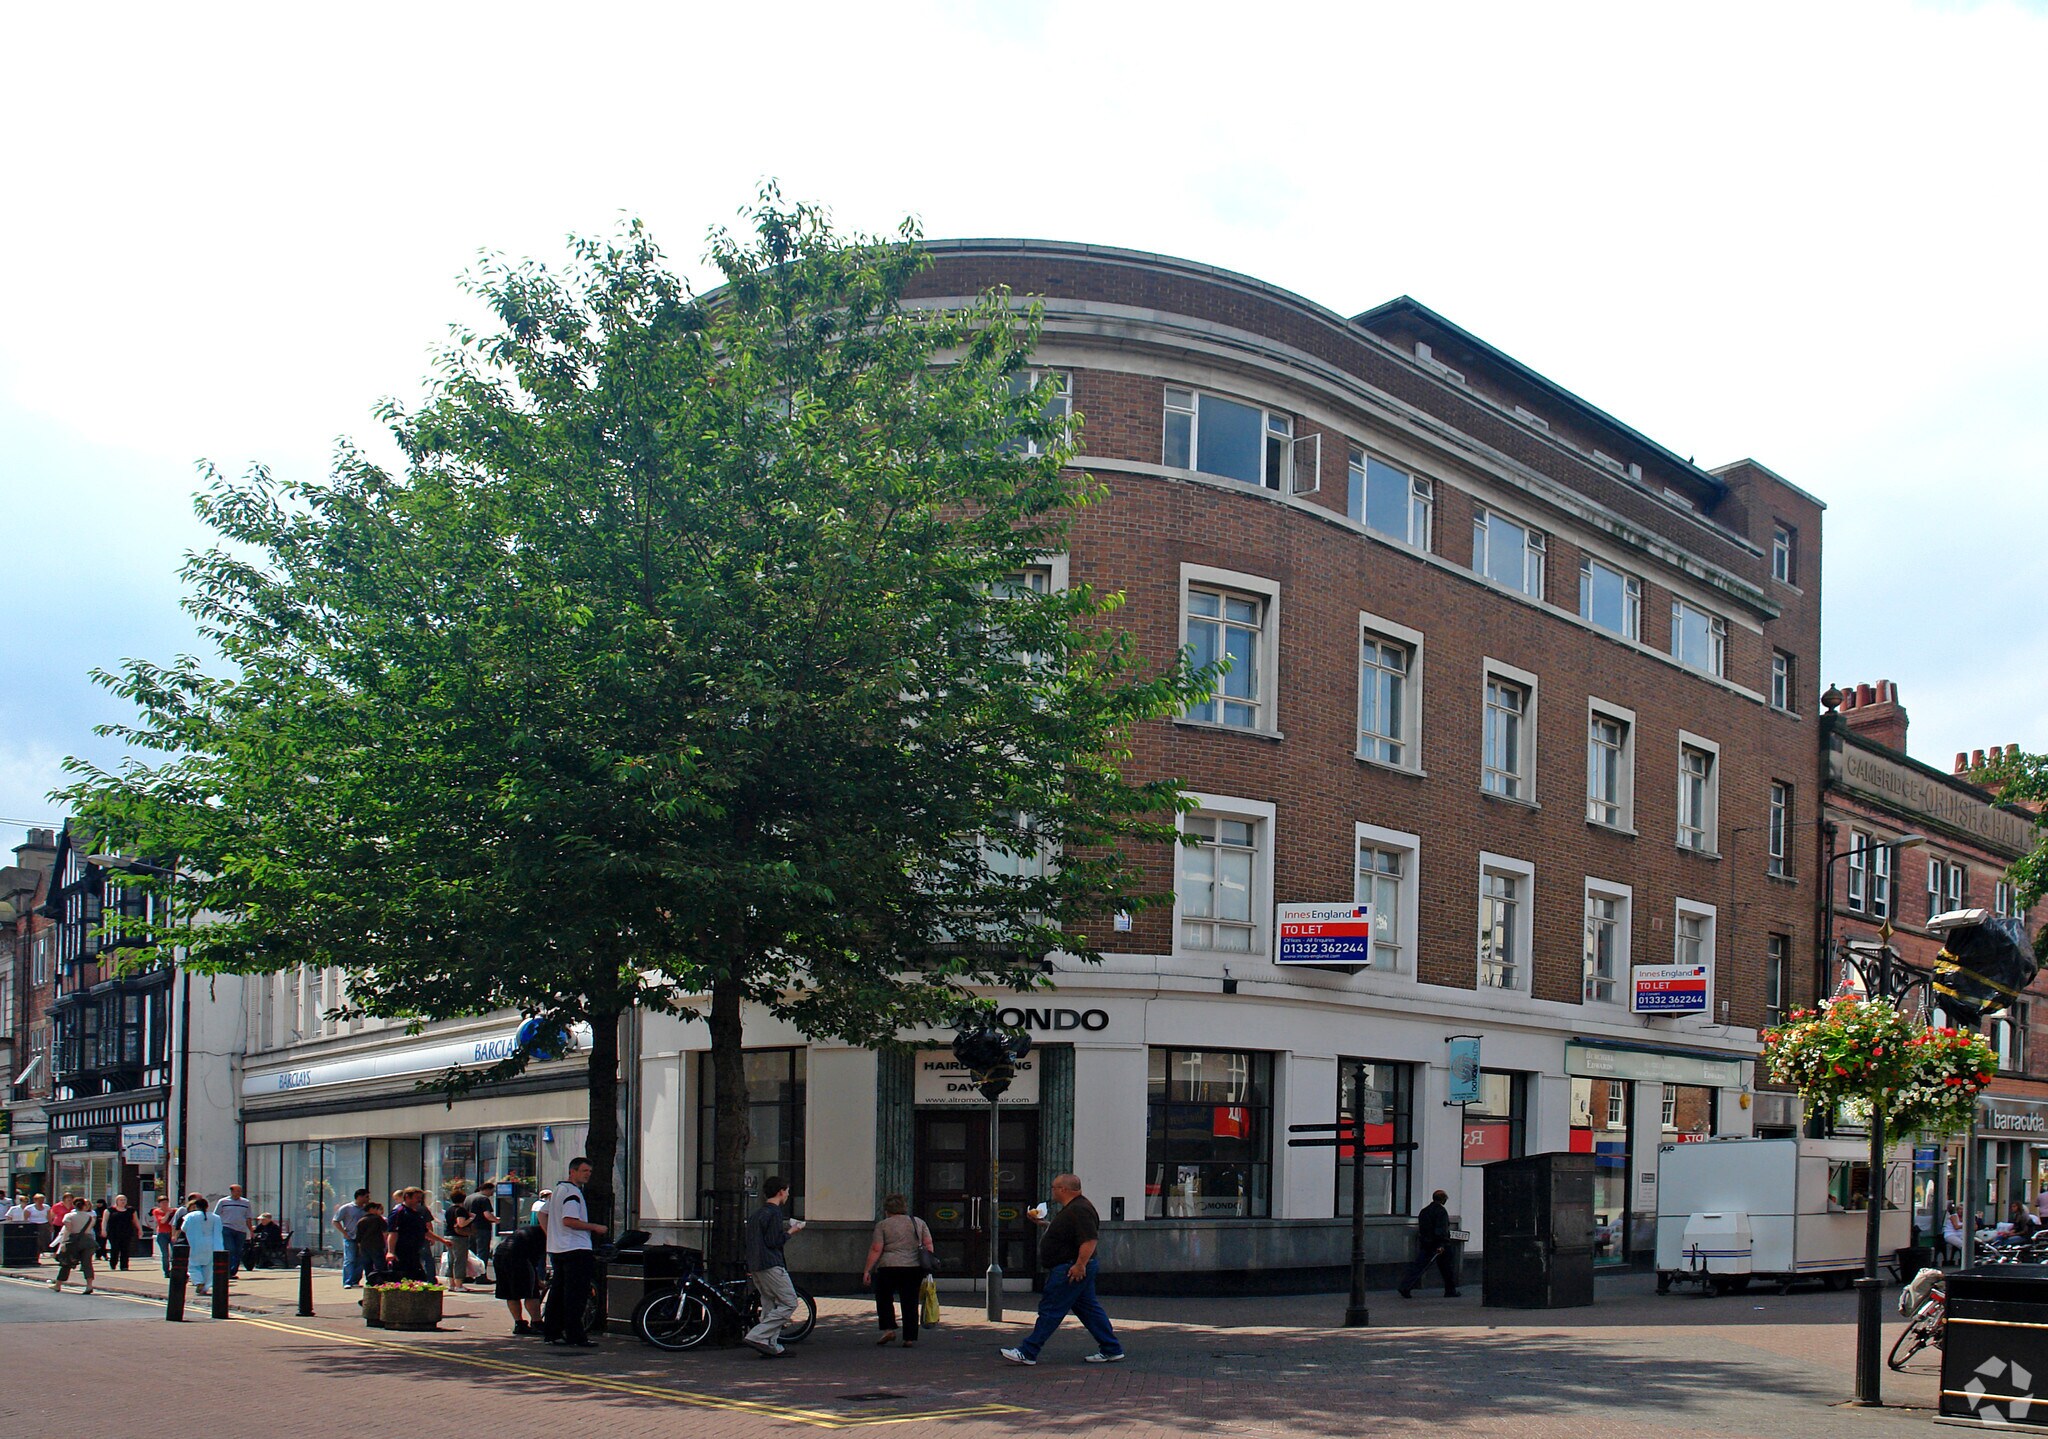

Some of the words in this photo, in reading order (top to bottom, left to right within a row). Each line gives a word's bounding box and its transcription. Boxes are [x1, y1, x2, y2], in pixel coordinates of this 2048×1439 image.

[1981, 812, 1988, 835] &
[1284, 925, 1298, 935] TO
[1301, 925, 1323, 934] LET
[1283, 943, 1318, 953] 01332
[1321, 943, 1365, 953] 362244
[1639, 982, 1651, 990] TO
[1653, 981, 1671, 989] LET
[1638, 996, 1667, 1005] 01332
[1668, 995, 1703, 1005] 362244
[279, 1070, 311, 1089] BARCLAYS
[947, 1083, 976, 1092] DAY
[1994, 1108, 2045, 1132] barracuda
